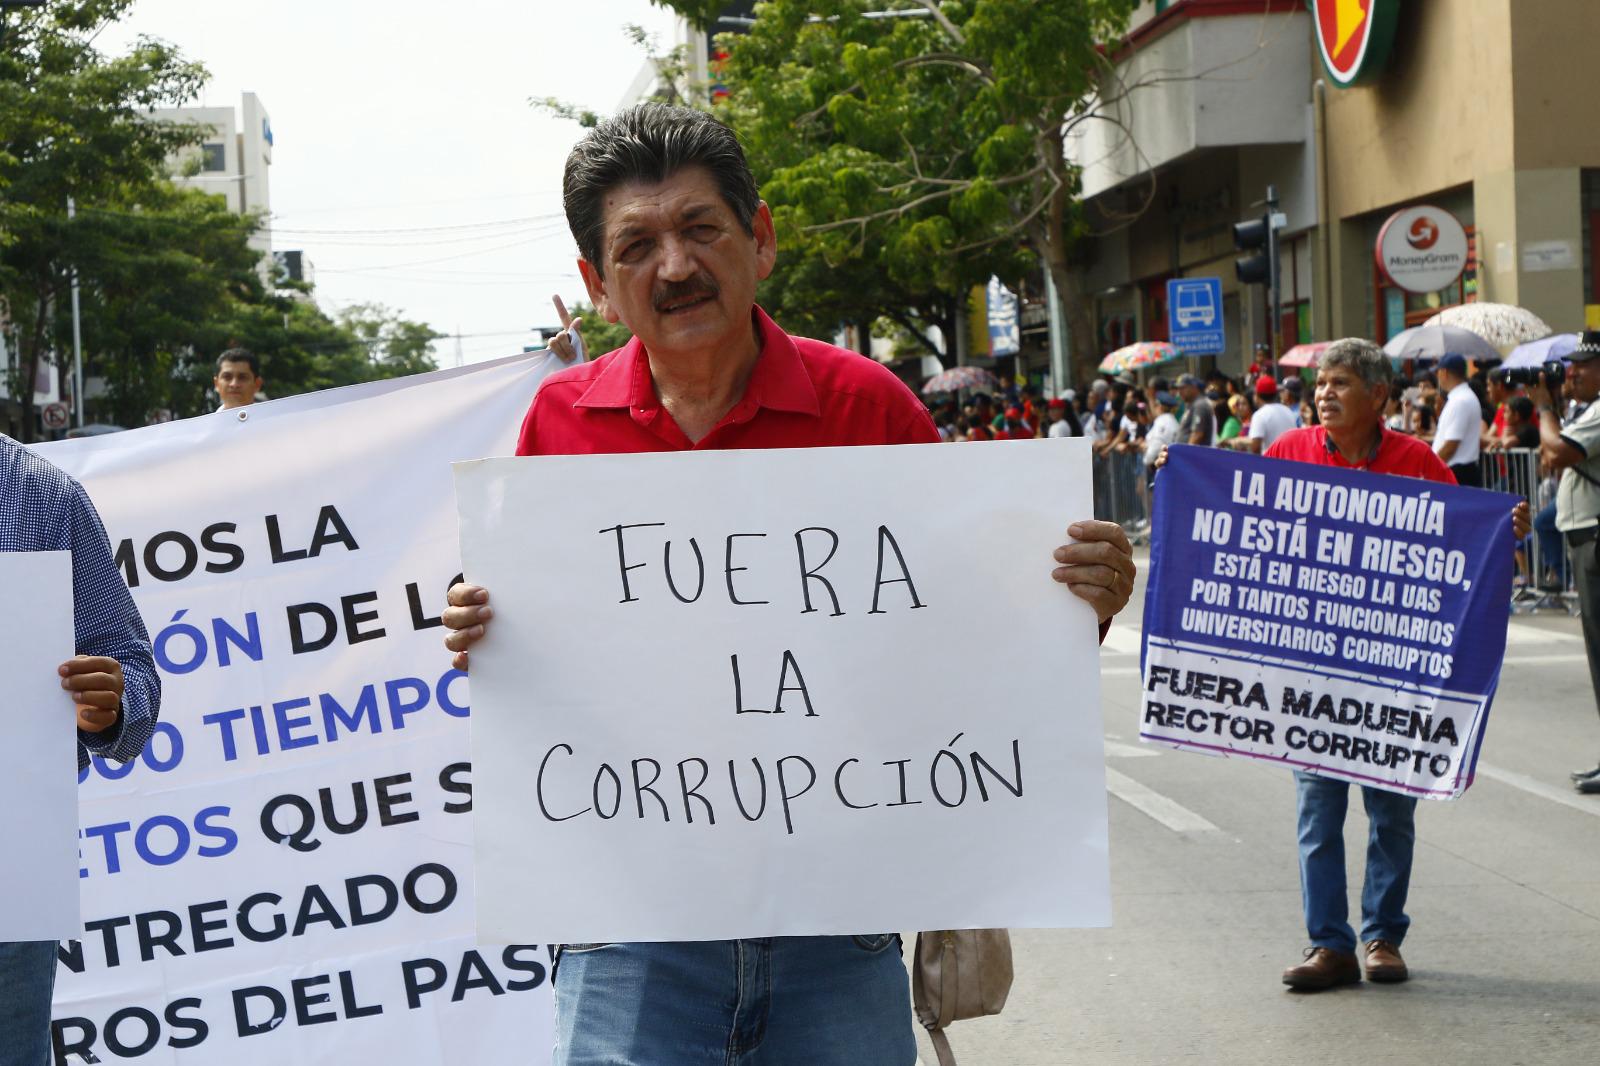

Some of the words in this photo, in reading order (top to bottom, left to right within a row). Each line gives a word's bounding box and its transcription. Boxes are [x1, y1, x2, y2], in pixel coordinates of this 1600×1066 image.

[1390, 253, 1459, 266] MoneyGram
[265, 505, 359, 564] LA
[1232, 470, 1265, 507] LA
[1274, 477, 1446, 536] AUTONOMÍA
[599, 522, 927, 616] FUERA
[1192, 508, 1232, 545] NO
[1240, 516, 1307, 559] ESTÁ
[1316, 528, 1354, 566] EN
[1361, 536, 1471, 591] RIESGO,
[1213, 551, 1261, 581] ESTÁ
[1267, 560, 1292, 587] EN
[1297, 566, 1366, 600] RIESGO
[1371, 578, 1395, 605] LA
[1402, 584, 1442, 613] UAS
[153, 609, 263, 675] ÓN
[286, 591, 386, 655] DE
[405, 573, 464, 630] L
[1181, 608, 1337, 656] UNIVERSITARIOS
[1342, 636, 1453, 679] CORRUPTOS
[1191, 578, 1231, 607] POR
[1237, 586, 1309, 620] TANTOS
[1314, 600, 1455, 647] FUNCIONARIOS
[731, 649, 820, 717] LA
[1148, 665, 1269, 711] FUERA
[1281, 687, 1459, 747] MADUEÑA
[1145, 700, 1275, 744] RECTOR
[1285, 725, 1451, 777] CORRUPTO
[537, 732, 1023, 834] CORRUPCIÓN
[79, 806, 238, 878] TOS
[260, 772, 420, 852] QUE
[232, 970, 383, 1038] DEL
[402, 944, 555, 1009] PAS
